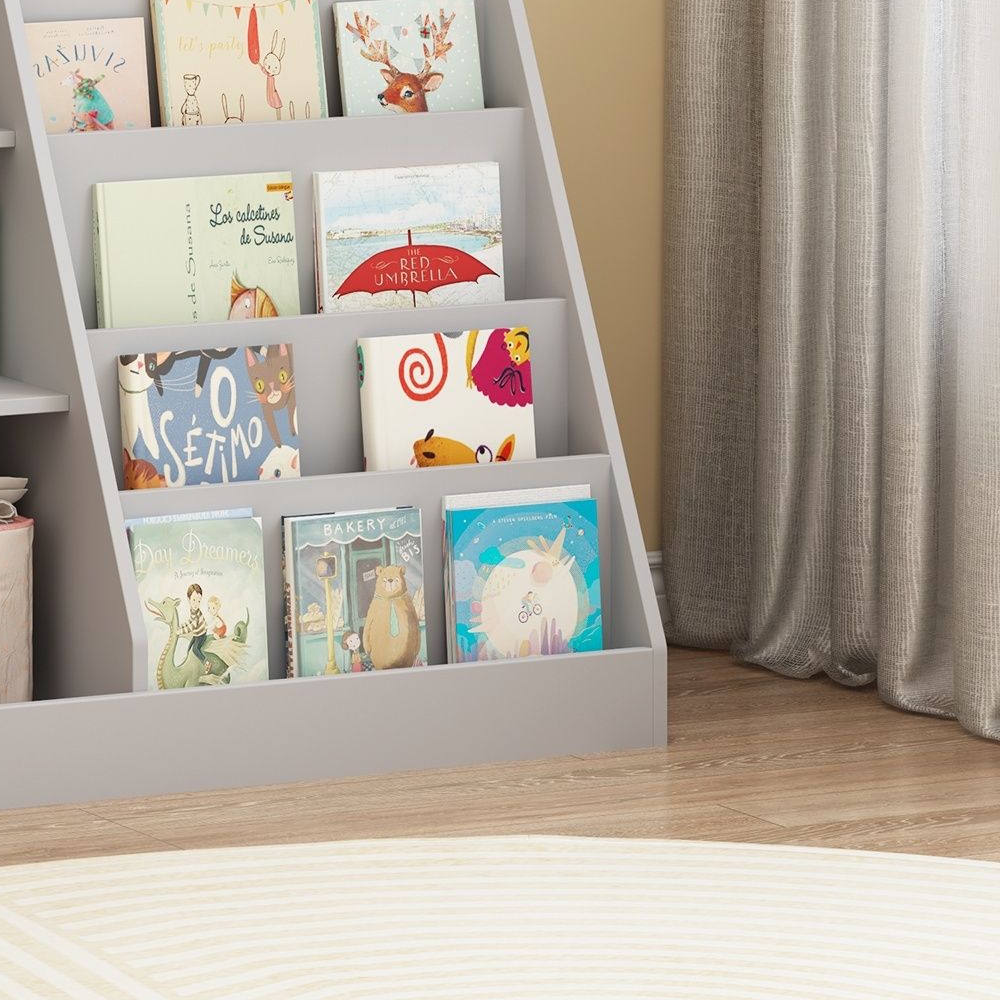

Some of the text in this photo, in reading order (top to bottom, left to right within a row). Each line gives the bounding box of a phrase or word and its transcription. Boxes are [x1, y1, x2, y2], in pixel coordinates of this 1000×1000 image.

[208, 33, 245, 61] party
[209, 203, 281, 227] Los calcetines
[185, 203, 197, 276] Susana
[239, 224, 294, 247] de Susana
[400, 256, 431, 271] RED
[406, 248, 422, 257] THE
[374, 267, 458, 287] UMBRELLA
[209, 366, 238, 429] O
[323, 516, 386, 537] BAKERY
[134, 528, 259, 576] Day Dreamers
